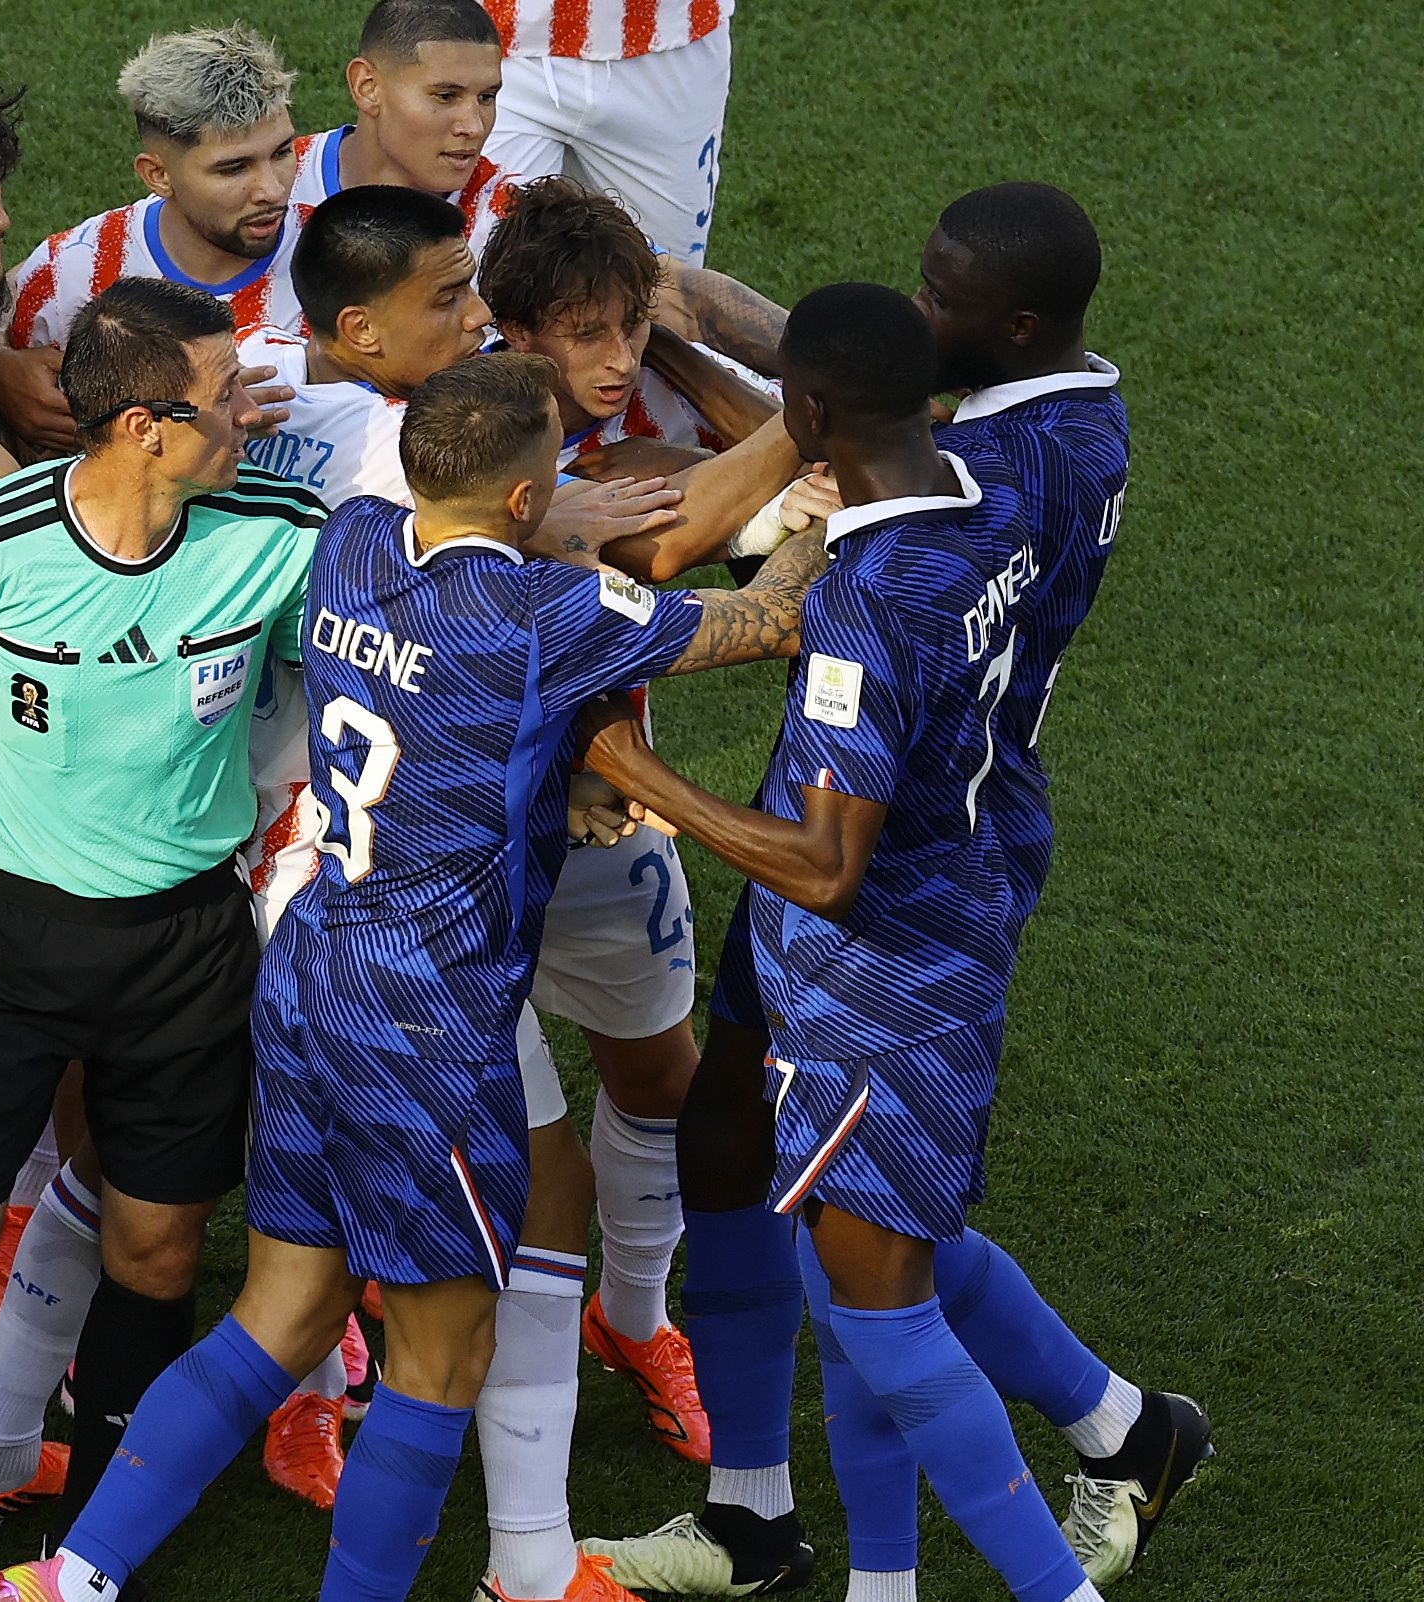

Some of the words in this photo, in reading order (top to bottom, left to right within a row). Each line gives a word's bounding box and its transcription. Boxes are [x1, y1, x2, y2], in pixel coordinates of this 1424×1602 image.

[696, 132, 716, 228] 3
[312, 606, 433, 694] DIGNE
[197, 654, 246, 685] FIFA
[197, 679, 244, 707] REFEREE
[814, 695, 849, 712] EDUCATION
[21, 715, 40, 729] FIFA
[965, 624, 1017, 836] 7
[315, 695, 402, 884] 3
[392, 1021, 445, 1037] AERO-FIT
[775, 1057, 796, 1121] 7
[637, 1191, 682, 1201] AP
[12, 1271, 61, 1306] APF
